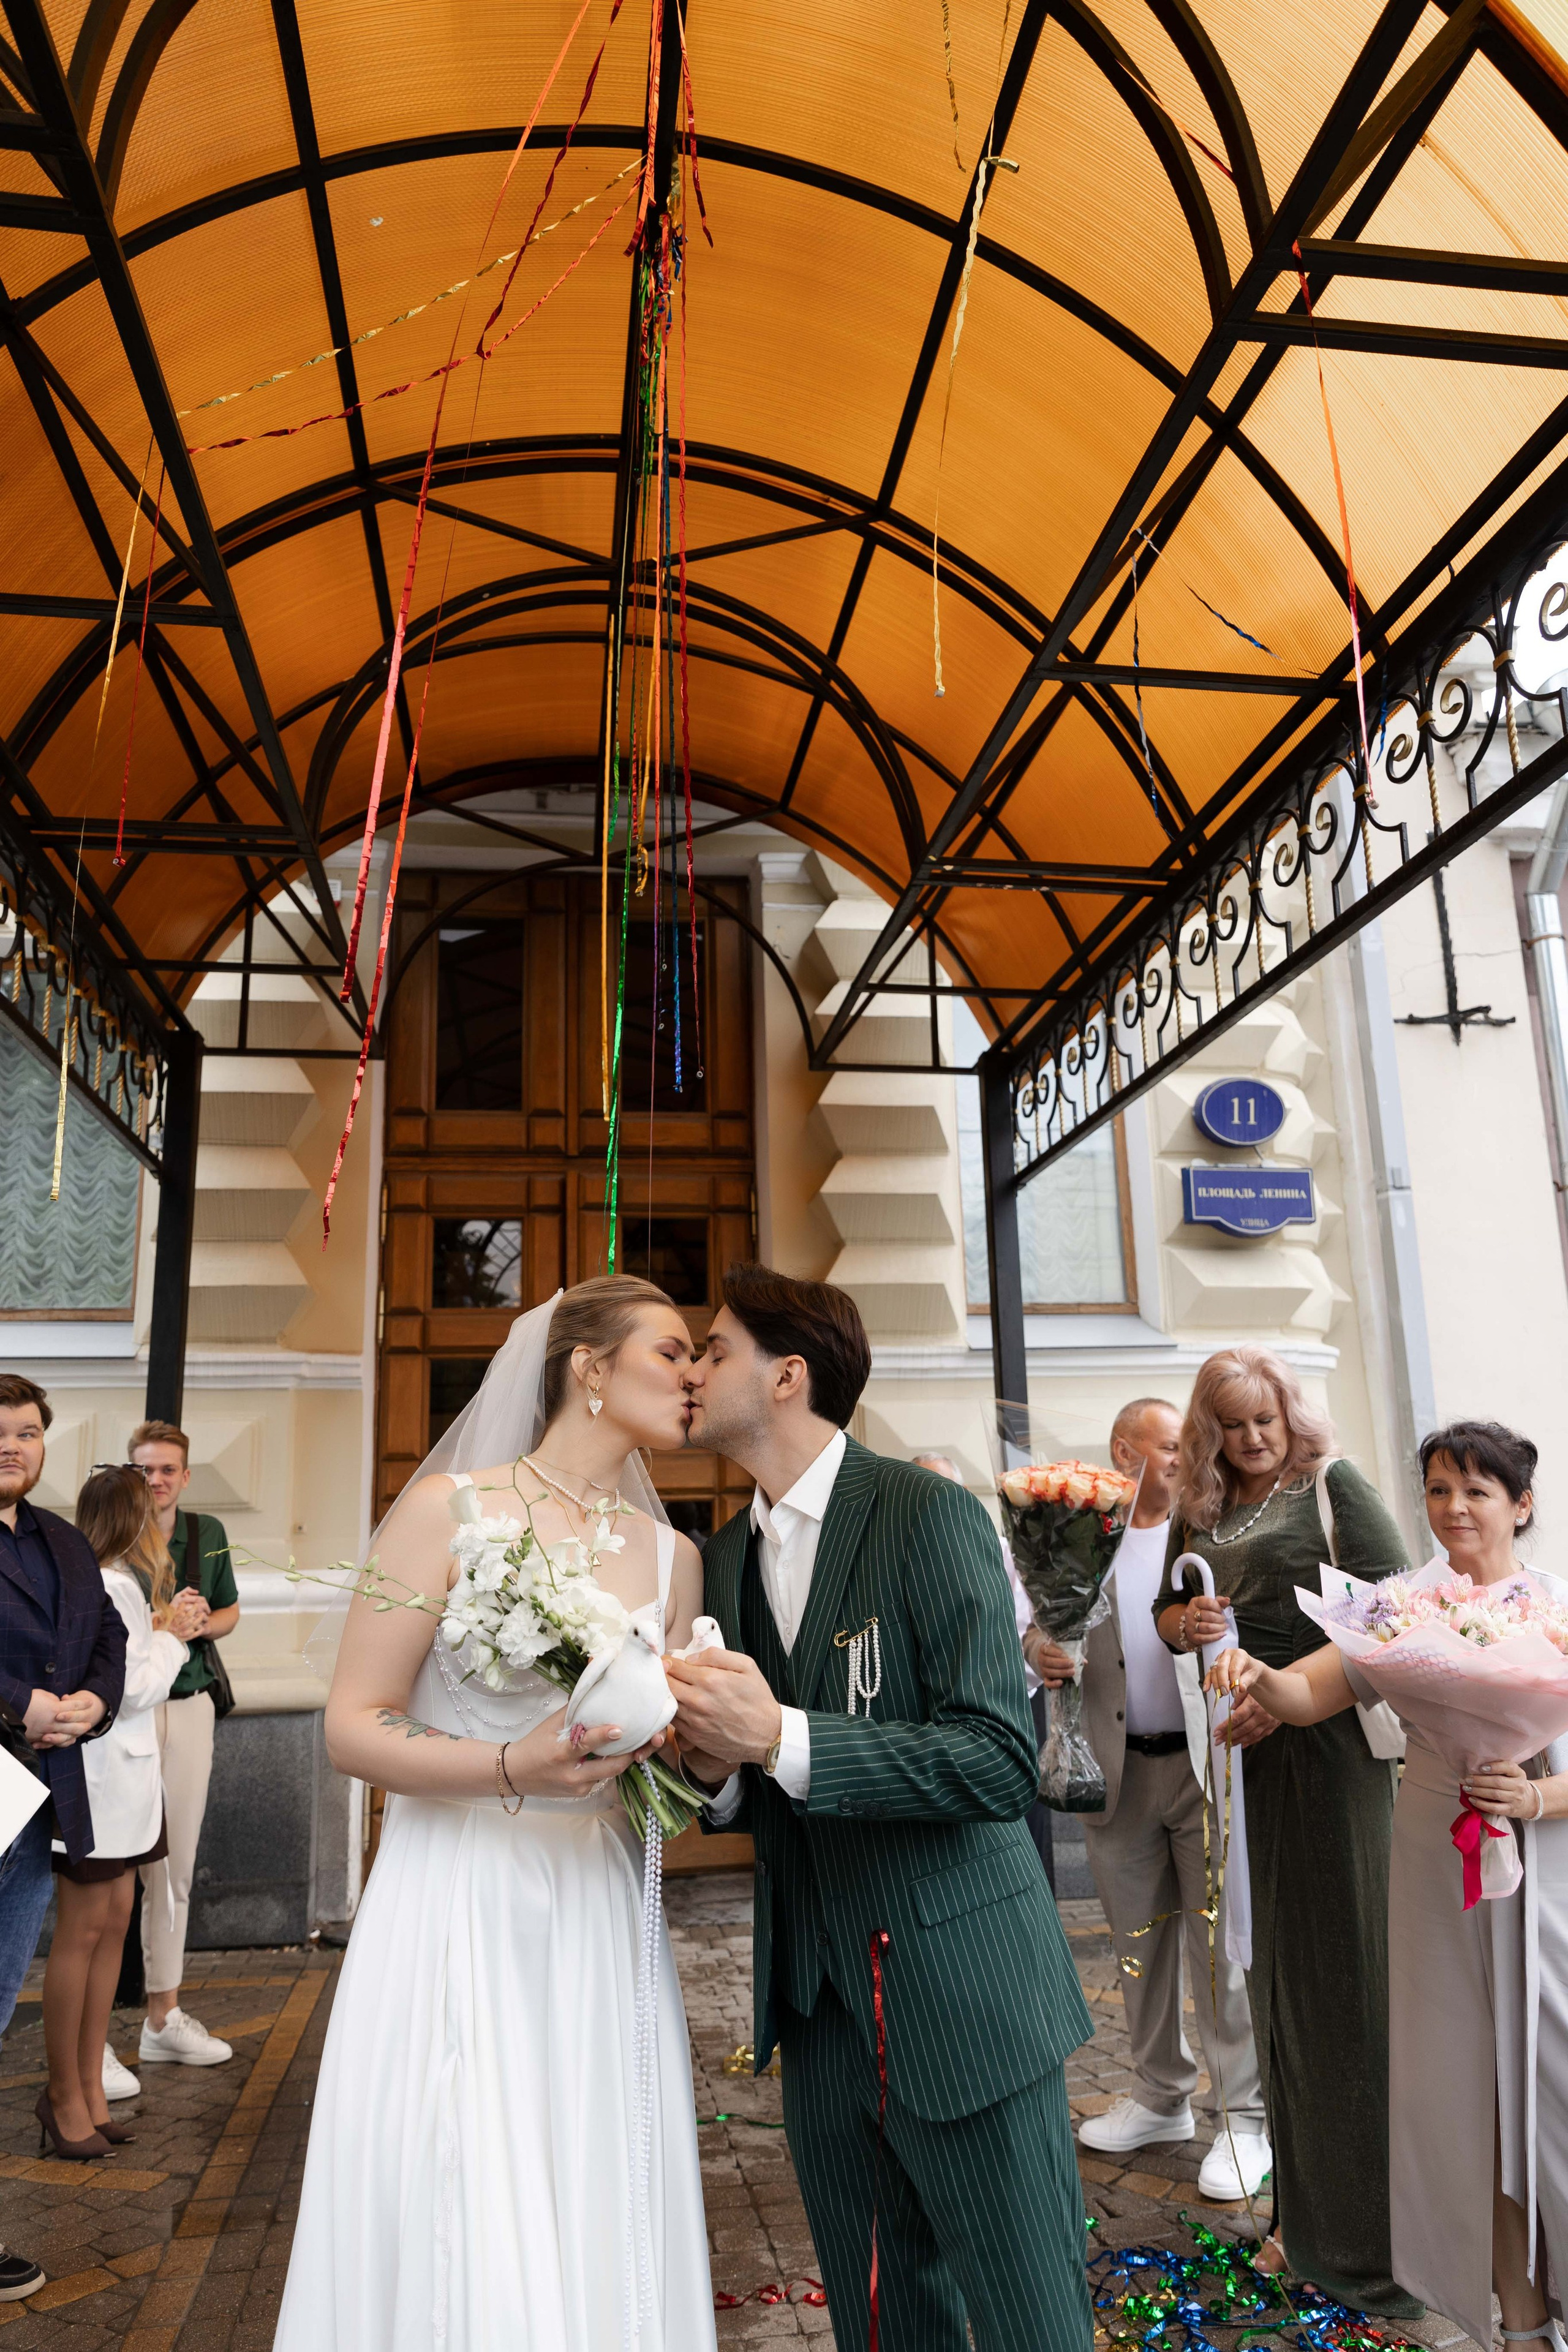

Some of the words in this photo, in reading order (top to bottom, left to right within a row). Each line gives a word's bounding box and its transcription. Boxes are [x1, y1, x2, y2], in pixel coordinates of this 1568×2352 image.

[1231, 1097, 1257, 1125] 11
[1197, 1187, 1256, 1199] ПЛОЩАДЬ
[1259, 1188, 1308, 1199] ЛЕНИНА
